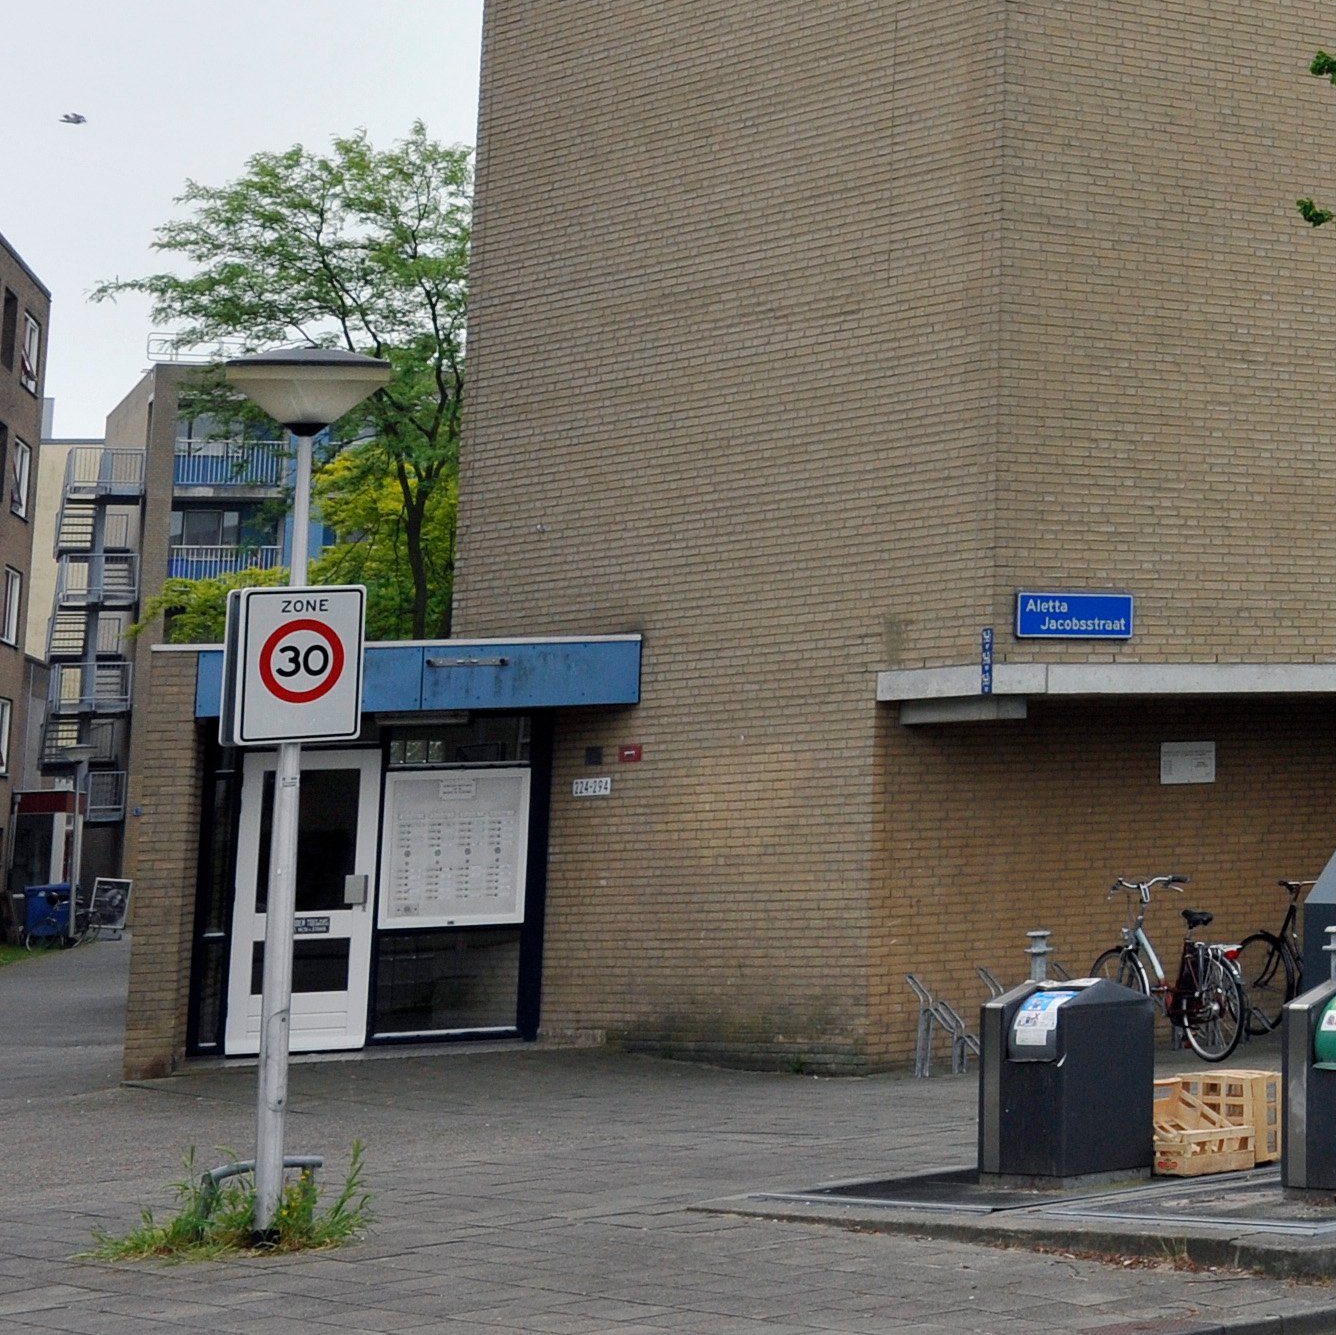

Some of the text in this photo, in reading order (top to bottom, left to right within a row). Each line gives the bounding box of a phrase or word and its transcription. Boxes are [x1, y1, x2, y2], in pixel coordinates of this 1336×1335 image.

[281, 599, 329, 613] ZONE
[1025, 598, 1068, 613] Aletta
[1040, 616, 1126, 631] Jacobsstraat
[275, 645, 329, 677] 30
[574, 779, 609, 795] 224-294
